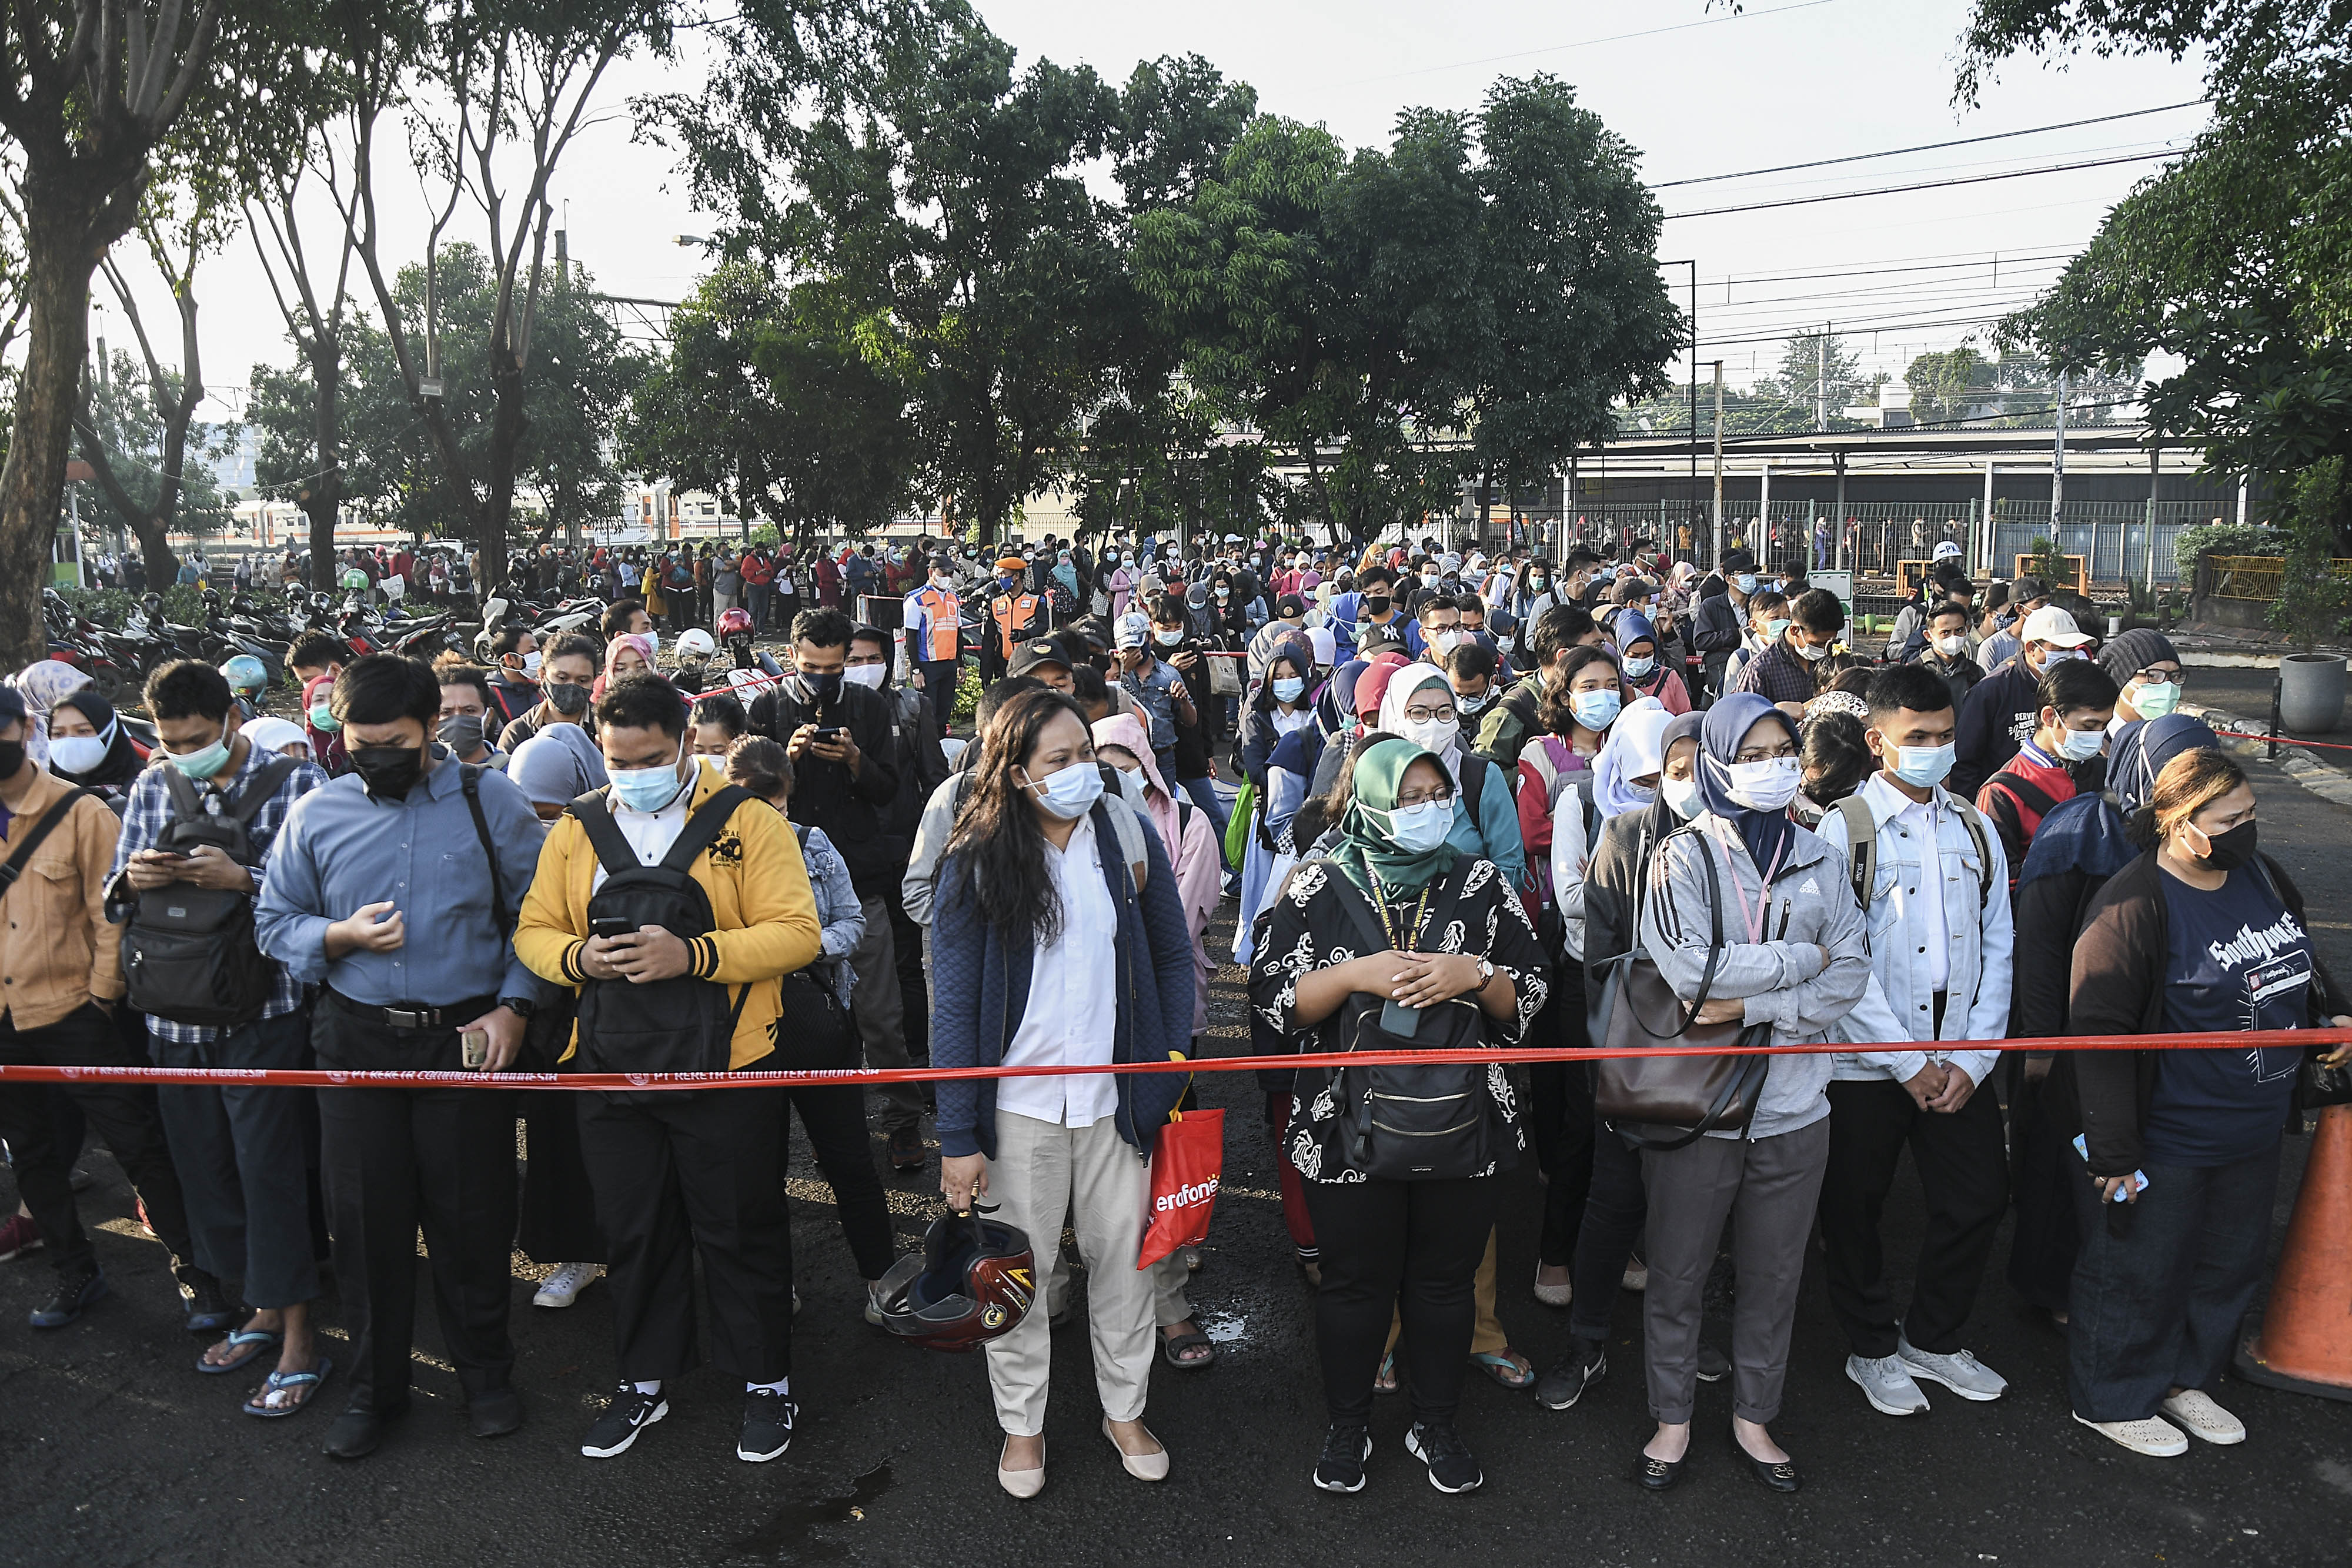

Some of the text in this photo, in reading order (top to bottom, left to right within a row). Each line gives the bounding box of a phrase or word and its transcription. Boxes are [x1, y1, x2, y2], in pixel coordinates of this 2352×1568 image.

[1381, 624, 1400, 640] NY
[1374, 886, 1391, 930] KEMENTERIAN
[1414, 888, 1429, 928] KEMENTERIAN
[1157, 1179, 1218, 1211] erafone
